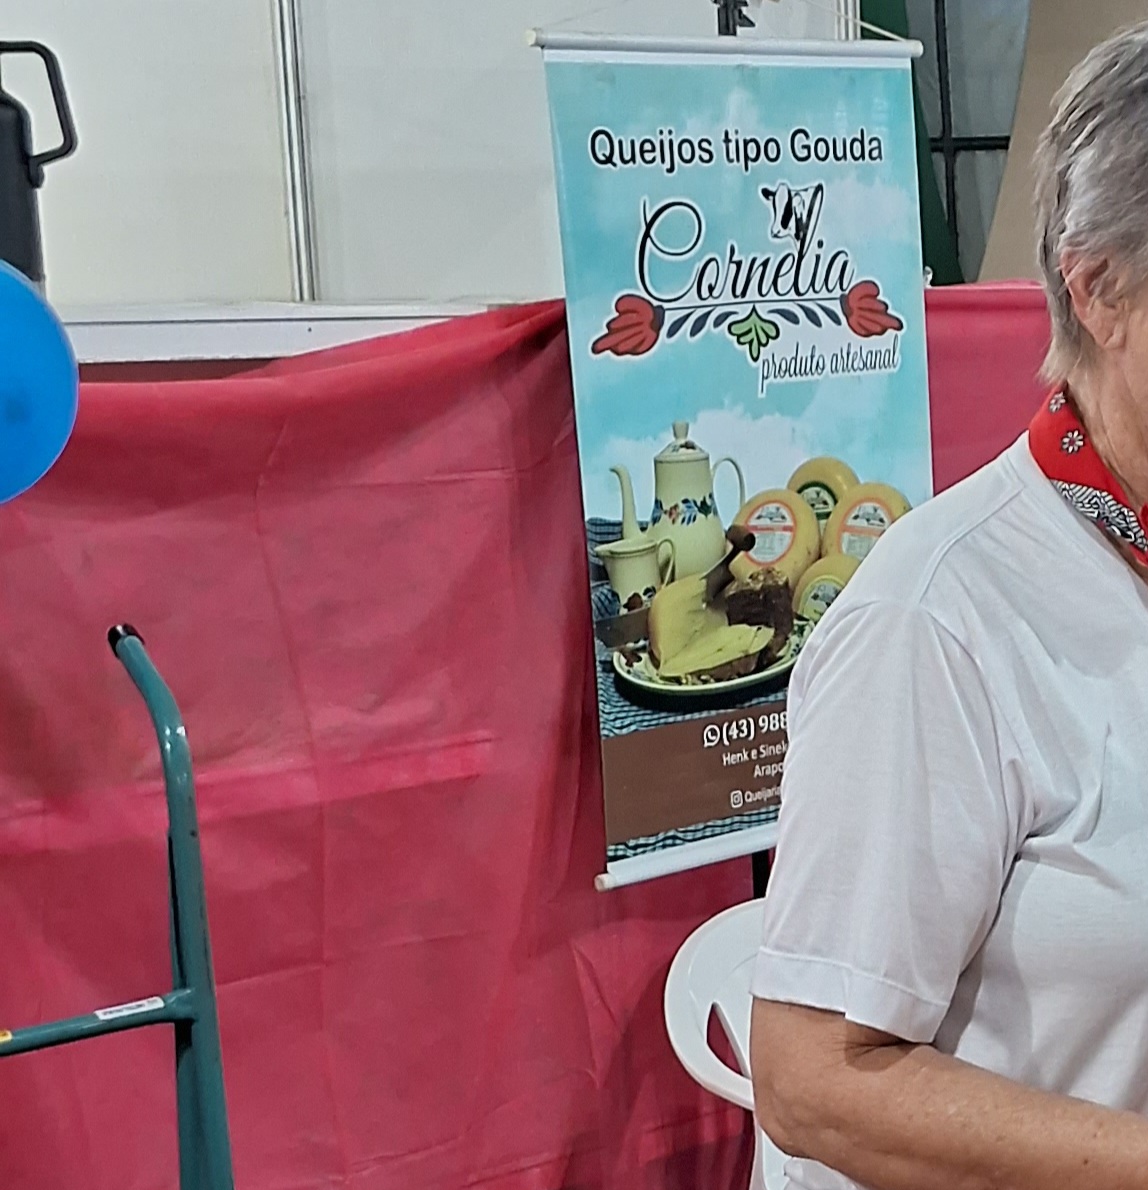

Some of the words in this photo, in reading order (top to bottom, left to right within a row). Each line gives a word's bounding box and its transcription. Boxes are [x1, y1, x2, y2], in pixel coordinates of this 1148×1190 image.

[589, 128, 714, 173] Queijos
[723, 128, 781, 171] tipo
[789, 127, 883, 162] Gouda
[637, 183, 856, 302] Cornelia
[760, 341, 827, 394] produto
[829, 334, 900, 374] artesanal
[722, 717, 755, 746] (43)
[722, 748, 749, 766] Henk
[751, 749, 758, 760] e
